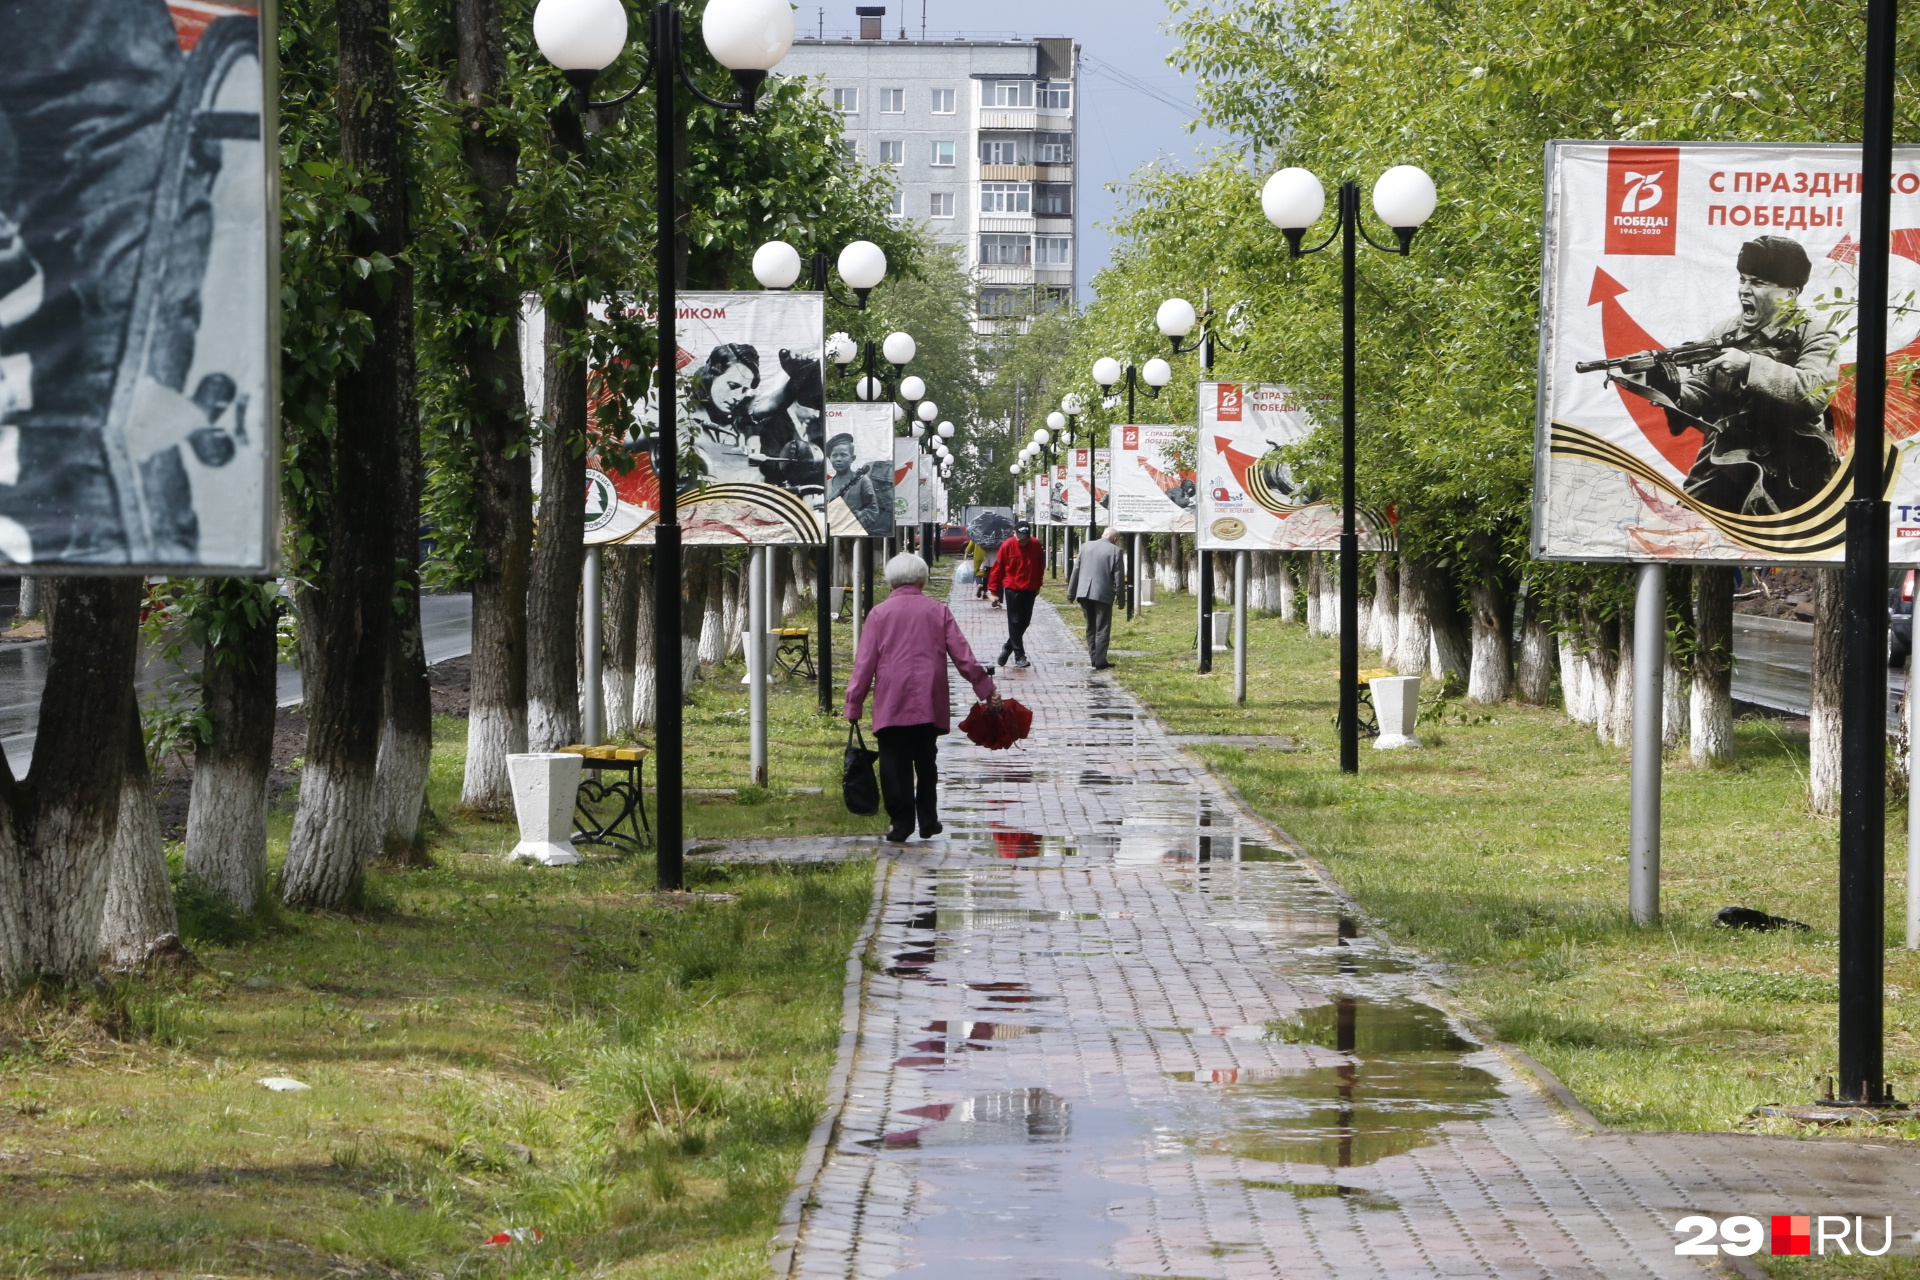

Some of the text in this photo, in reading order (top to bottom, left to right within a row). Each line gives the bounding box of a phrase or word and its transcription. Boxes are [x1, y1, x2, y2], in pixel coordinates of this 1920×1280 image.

[1621, 170, 1664, 213] 75
[1709, 171, 1725, 193] С
[1613, 215, 1669, 228] ПОБЕДА!
[1708, 205, 1843, 231] ПОБЕДЫ!
